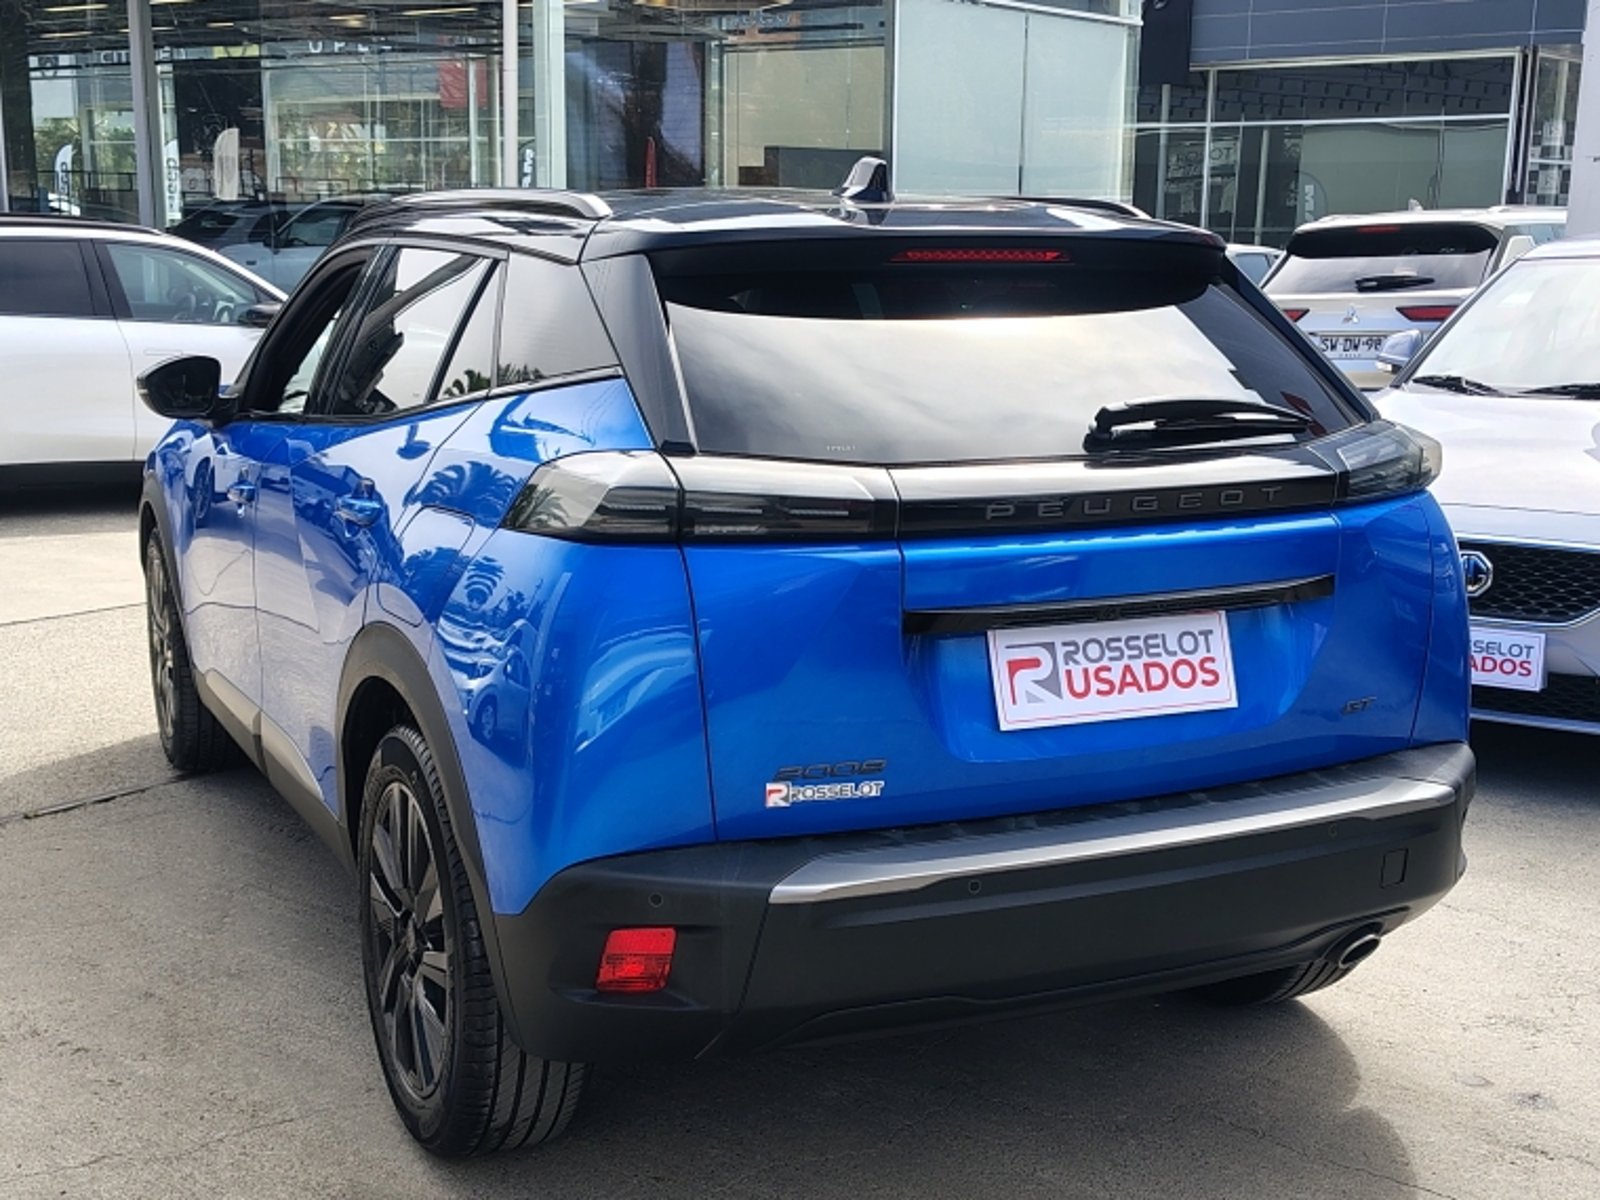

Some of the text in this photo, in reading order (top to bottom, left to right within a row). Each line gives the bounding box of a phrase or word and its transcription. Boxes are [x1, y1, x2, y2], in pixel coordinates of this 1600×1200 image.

[985, 486, 1283, 520] PEUGEOT
[1062, 629, 1214, 666] ROSSELOT
[1470, 639, 1535, 659] SELOT
[1065, 656, 1220, 699] USADOS
[773, 759, 887, 781] 2008
[790, 781, 885, 802] ROSSELOT
